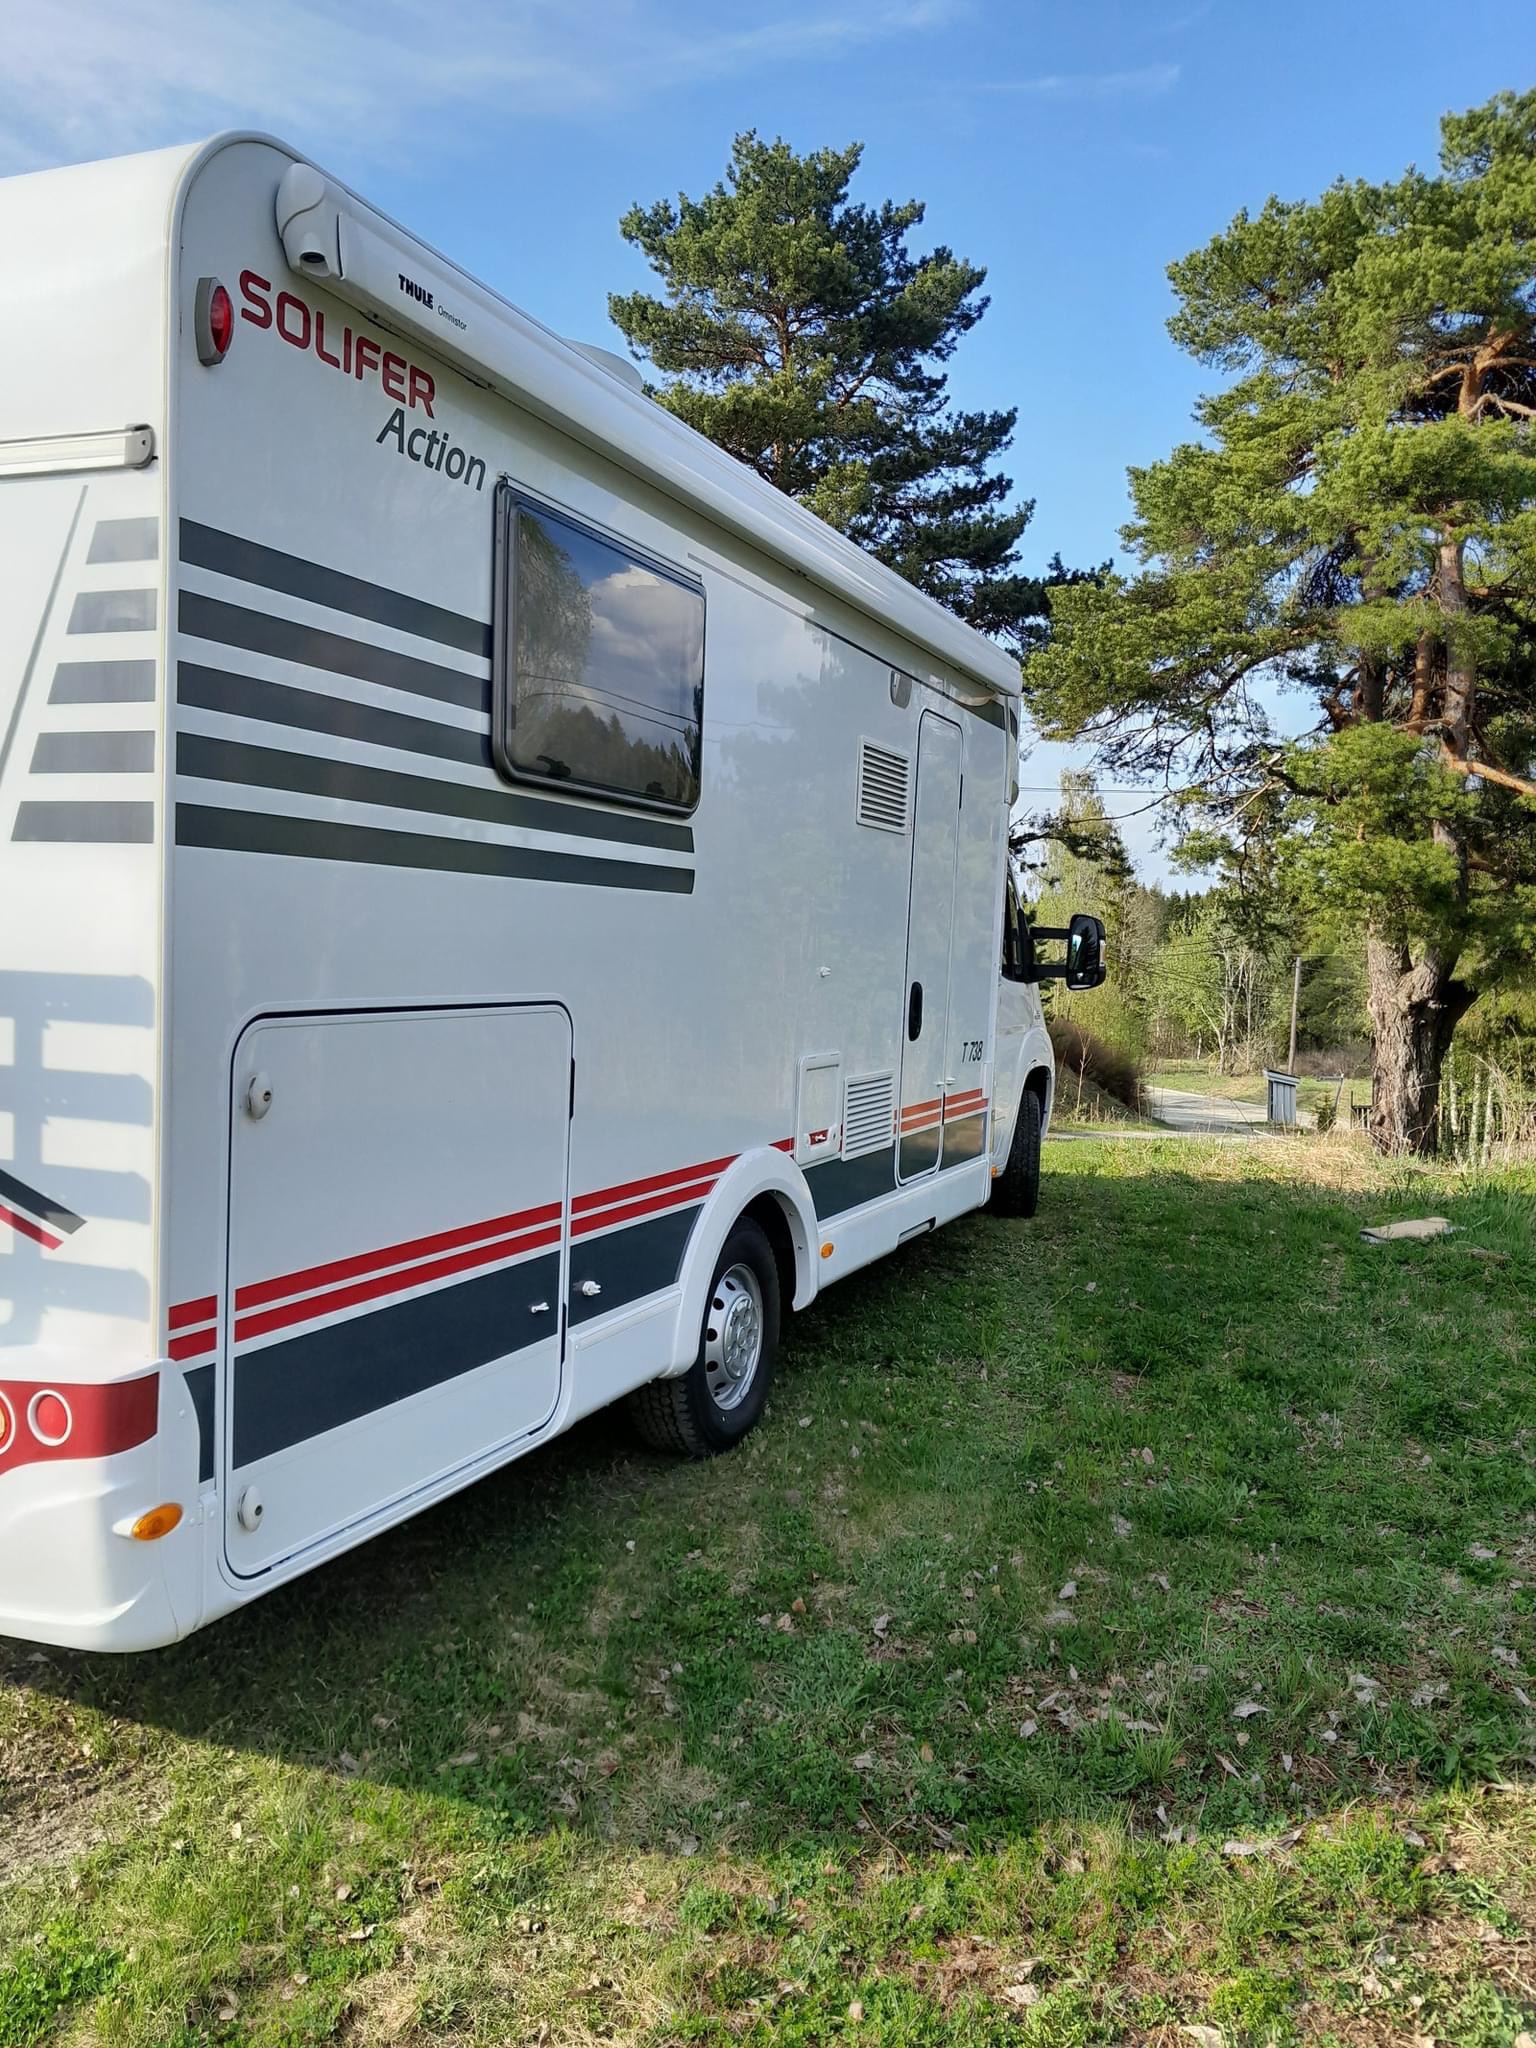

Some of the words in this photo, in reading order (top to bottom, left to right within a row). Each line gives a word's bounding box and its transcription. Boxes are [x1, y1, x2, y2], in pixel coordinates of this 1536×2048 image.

[398, 273, 434, 310] THULE
[437, 305, 468, 331] Omnistor
[239, 269, 436, 420] SOLIFER
[375, 407, 487, 491] Action
[962, 1041, 969, 1063] T
[968, 1040, 984, 1062] 738
